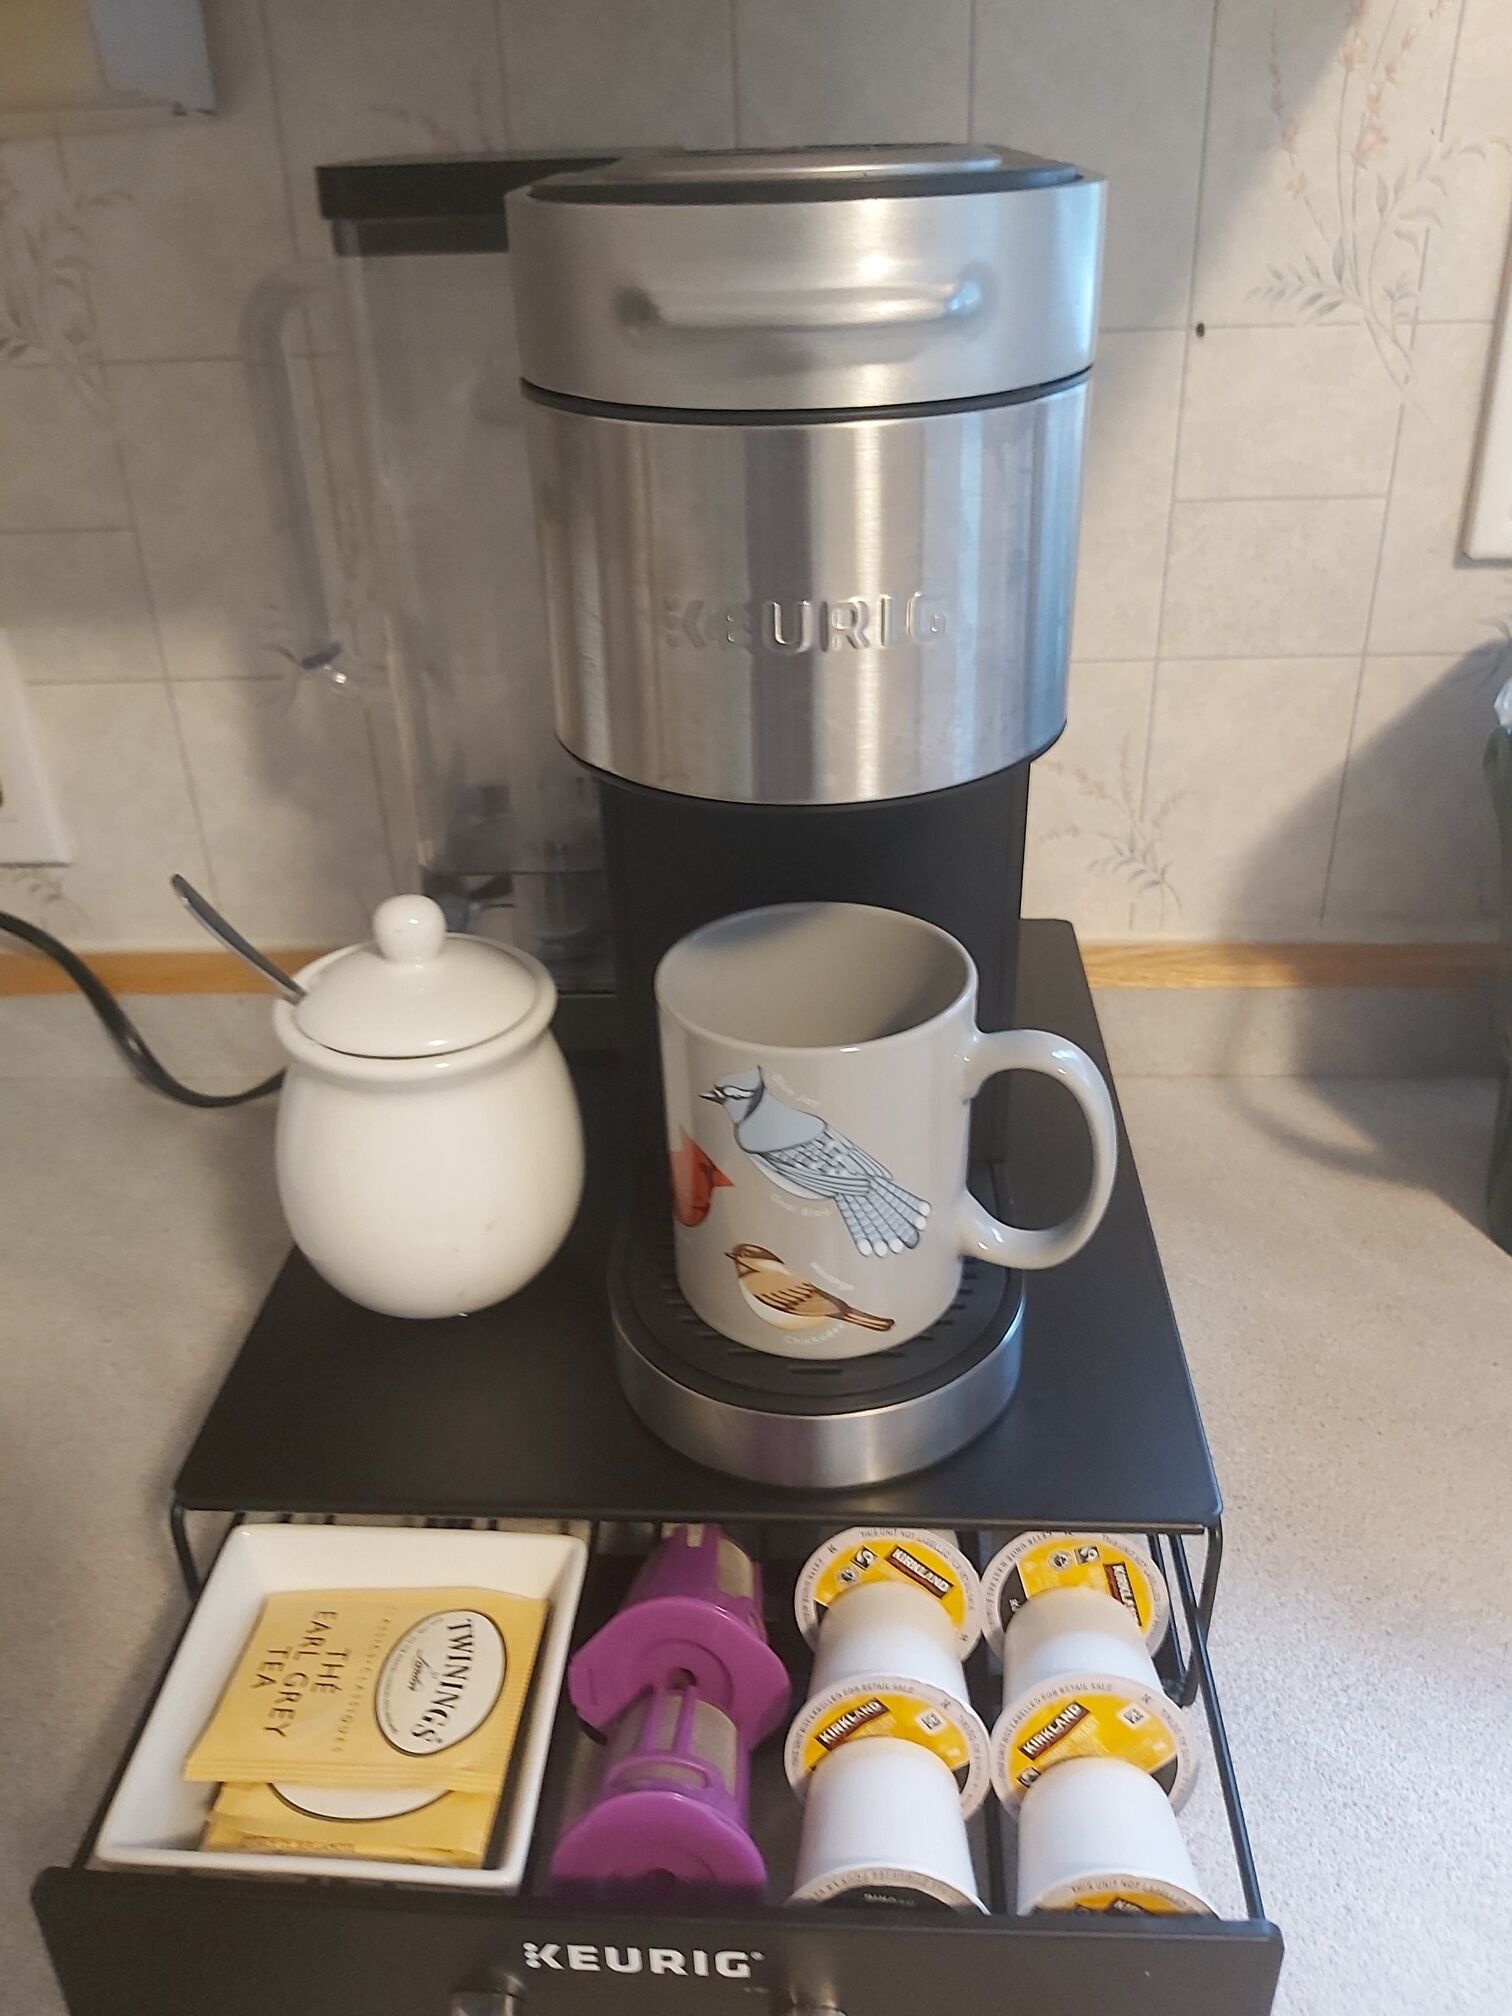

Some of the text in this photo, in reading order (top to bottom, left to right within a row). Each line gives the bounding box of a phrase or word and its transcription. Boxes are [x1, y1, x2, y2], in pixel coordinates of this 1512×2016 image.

[662, 591, 947, 655] KEURIG
[891, 1548, 951, 1593] KIRKLAND
[249, 1645, 293, 1689] TEA
[262, 1610, 339, 1738] EARL GREY
[310, 1648, 352, 1694] THE
[410, 1617, 474, 1743] TWININGS
[818, 1700, 882, 1745] KIRKLAND
[1022, 1702, 1083, 1756] KIRKLAND
[522, 1942, 752, 1978] KEURIG
